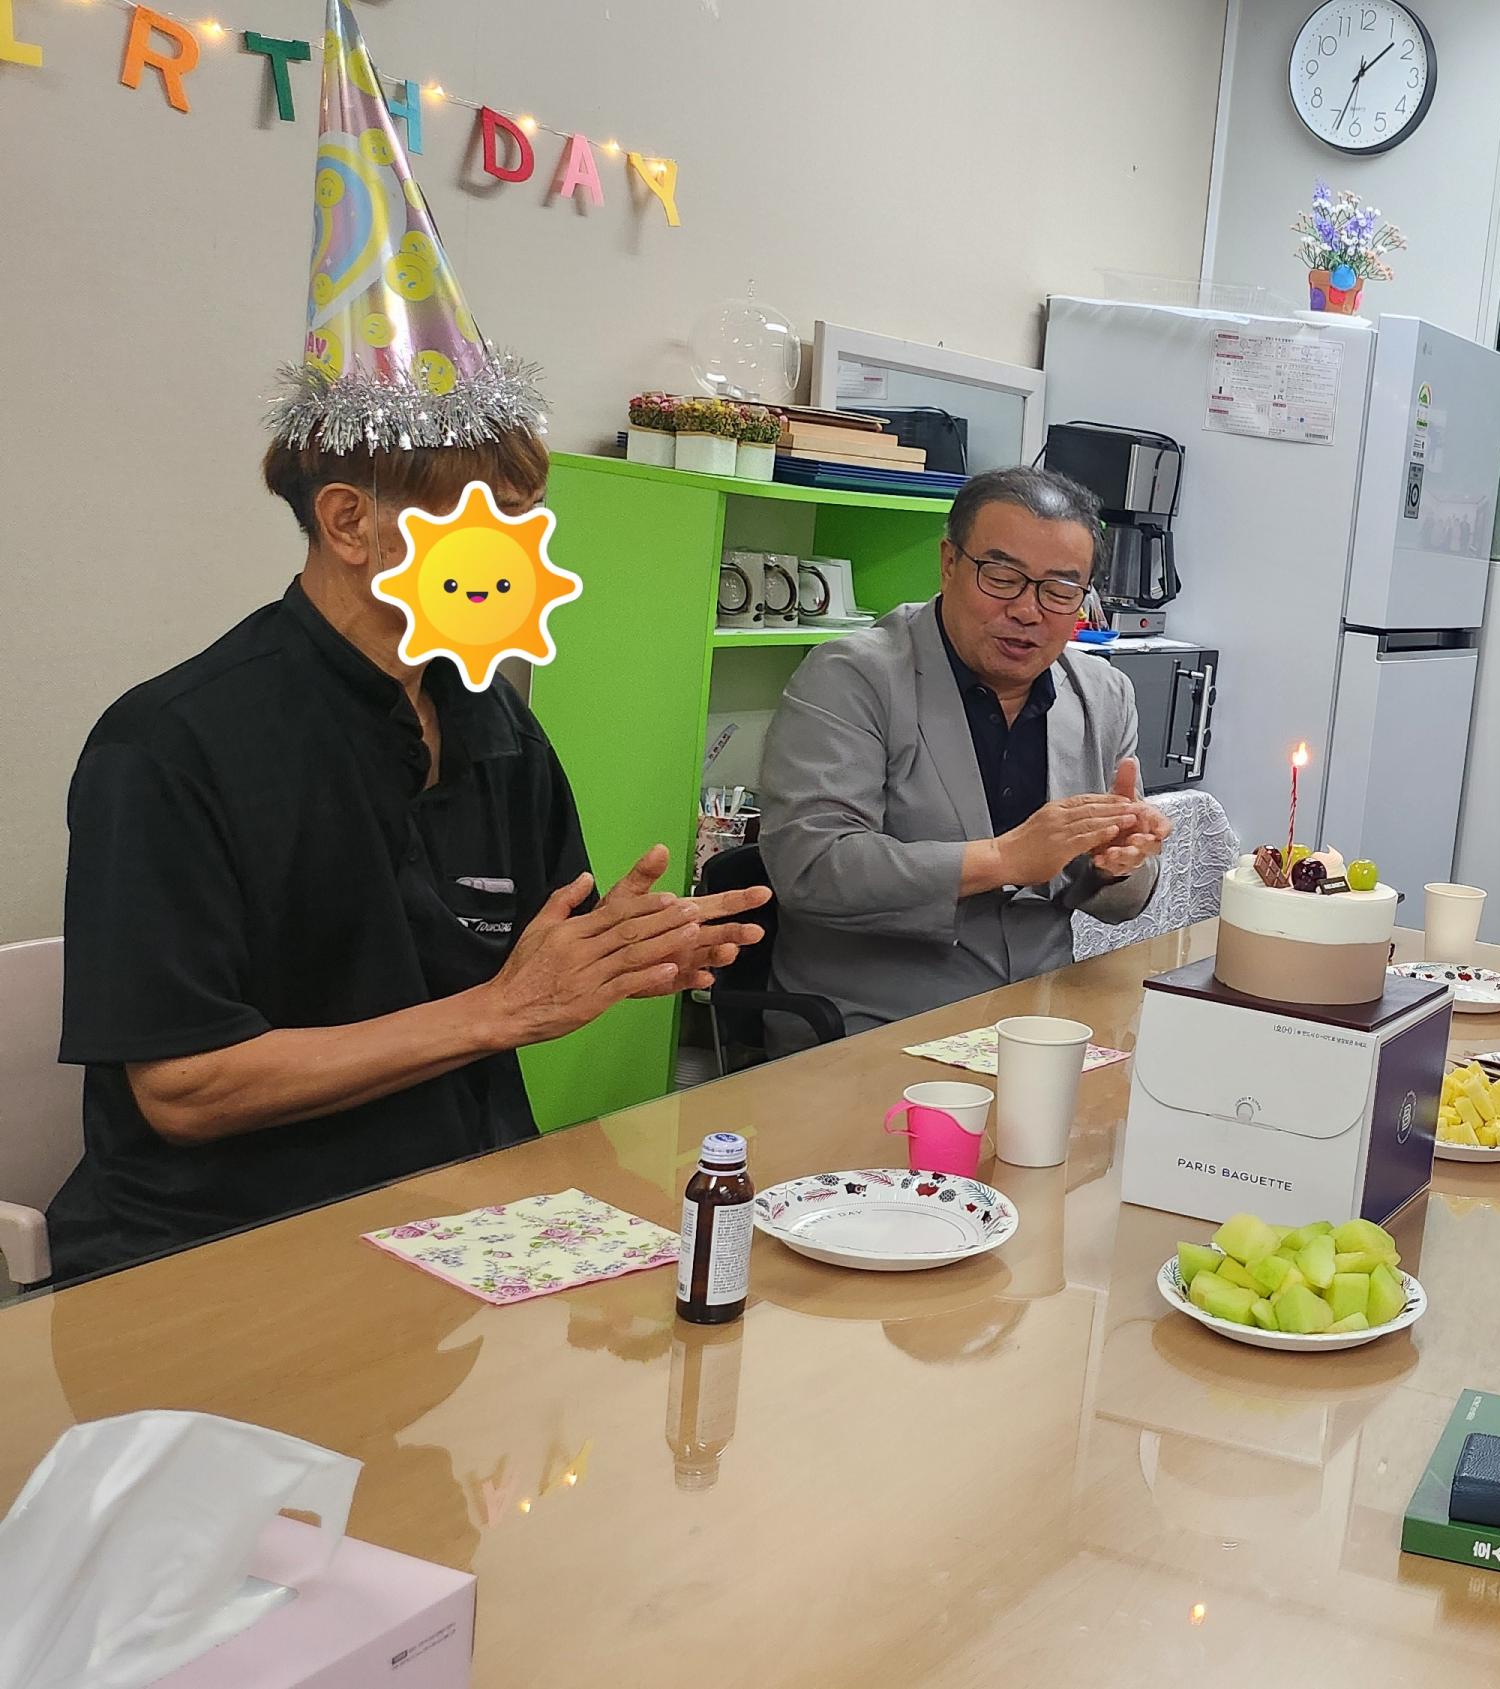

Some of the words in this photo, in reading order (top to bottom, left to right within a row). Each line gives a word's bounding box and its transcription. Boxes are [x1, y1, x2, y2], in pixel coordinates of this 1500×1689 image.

[1338, 16, 1351, 38] 11
[1360, 9, 1377, 31] 12
[1317, 35, 1338, 56] 10
[1400, 39, 1415, 60] 2
[1306, 59, 1319, 80] 9
[1406, 67, 1419, 89] 3
[1310, 87, 1323, 108] 8
[1394, 94, 1407, 115] 4
[1330, 109, 1342, 129] 7
[1348, 117, 1362, 138] 6
[1373, 112, 1387, 133] 5
[1177, 1158, 1217, 1175] PARIS
[1221, 1167, 1293, 1192] BAGUETTE
